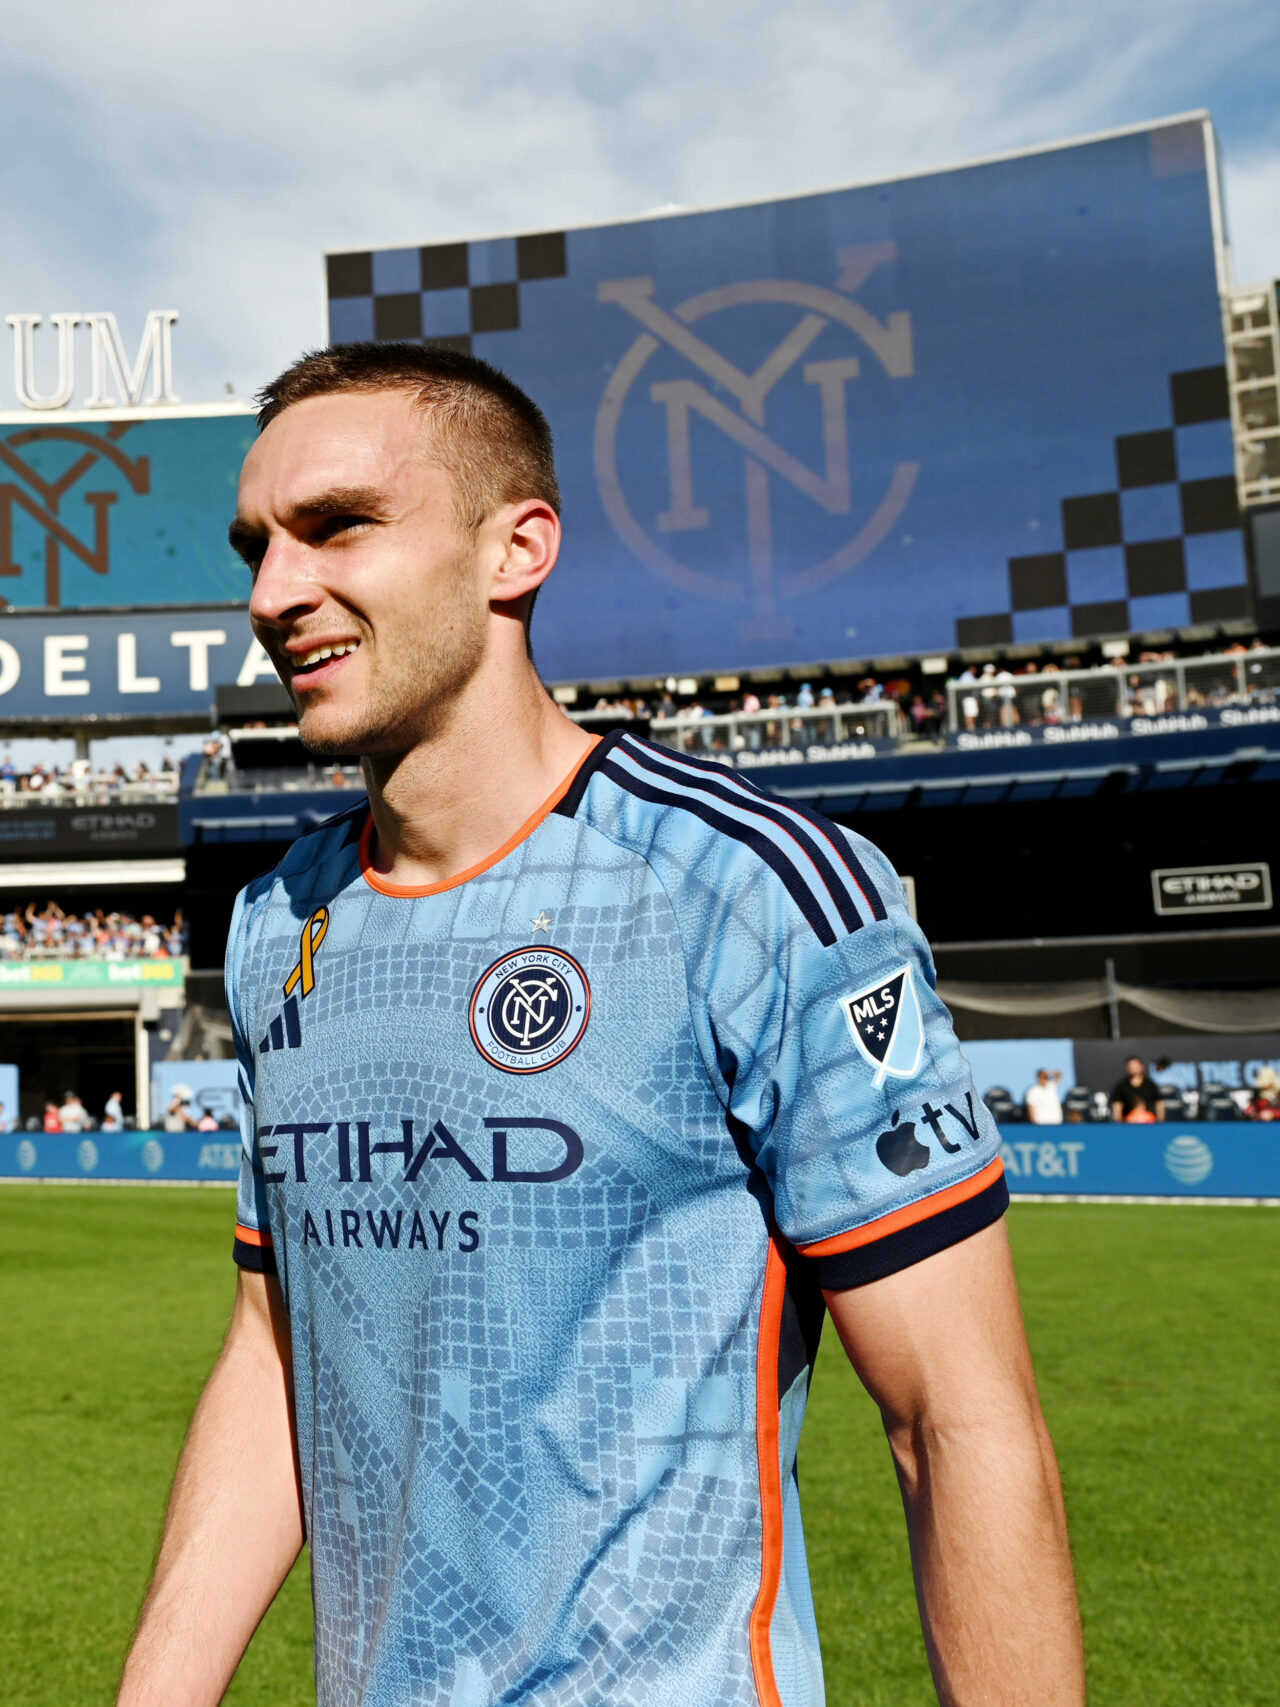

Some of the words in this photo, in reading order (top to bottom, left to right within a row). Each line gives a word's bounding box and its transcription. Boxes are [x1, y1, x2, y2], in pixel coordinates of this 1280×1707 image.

[957, 730, 1032, 751] StubHub
[1043, 723, 1119, 745] StubHub
[1130, 714, 1208, 737] StubHub
[1220, 705, 1280, 728] StubH
[737, 749, 804, 769] StubHub
[807, 743, 876, 763] StubHub
[72, 812, 157, 831] ETIHAD
[1162, 873, 1260, 894] ETIHAD
[108, 962, 175, 982] bet365
[495, 959, 519, 979] NEW
[521, 954, 551, 964] YORK
[551, 957, 573, 976] CITY
[852, 987, 896, 1024] MLS
[486, 1040, 539, 1066] FOOTBALL
[540, 1039, 567, 1062] CLUB
[921, 1091, 981, 1154] tv
[258, 1116, 585, 1184] ETIHAD
[303, 1209, 481, 1253] AIRWAYS
